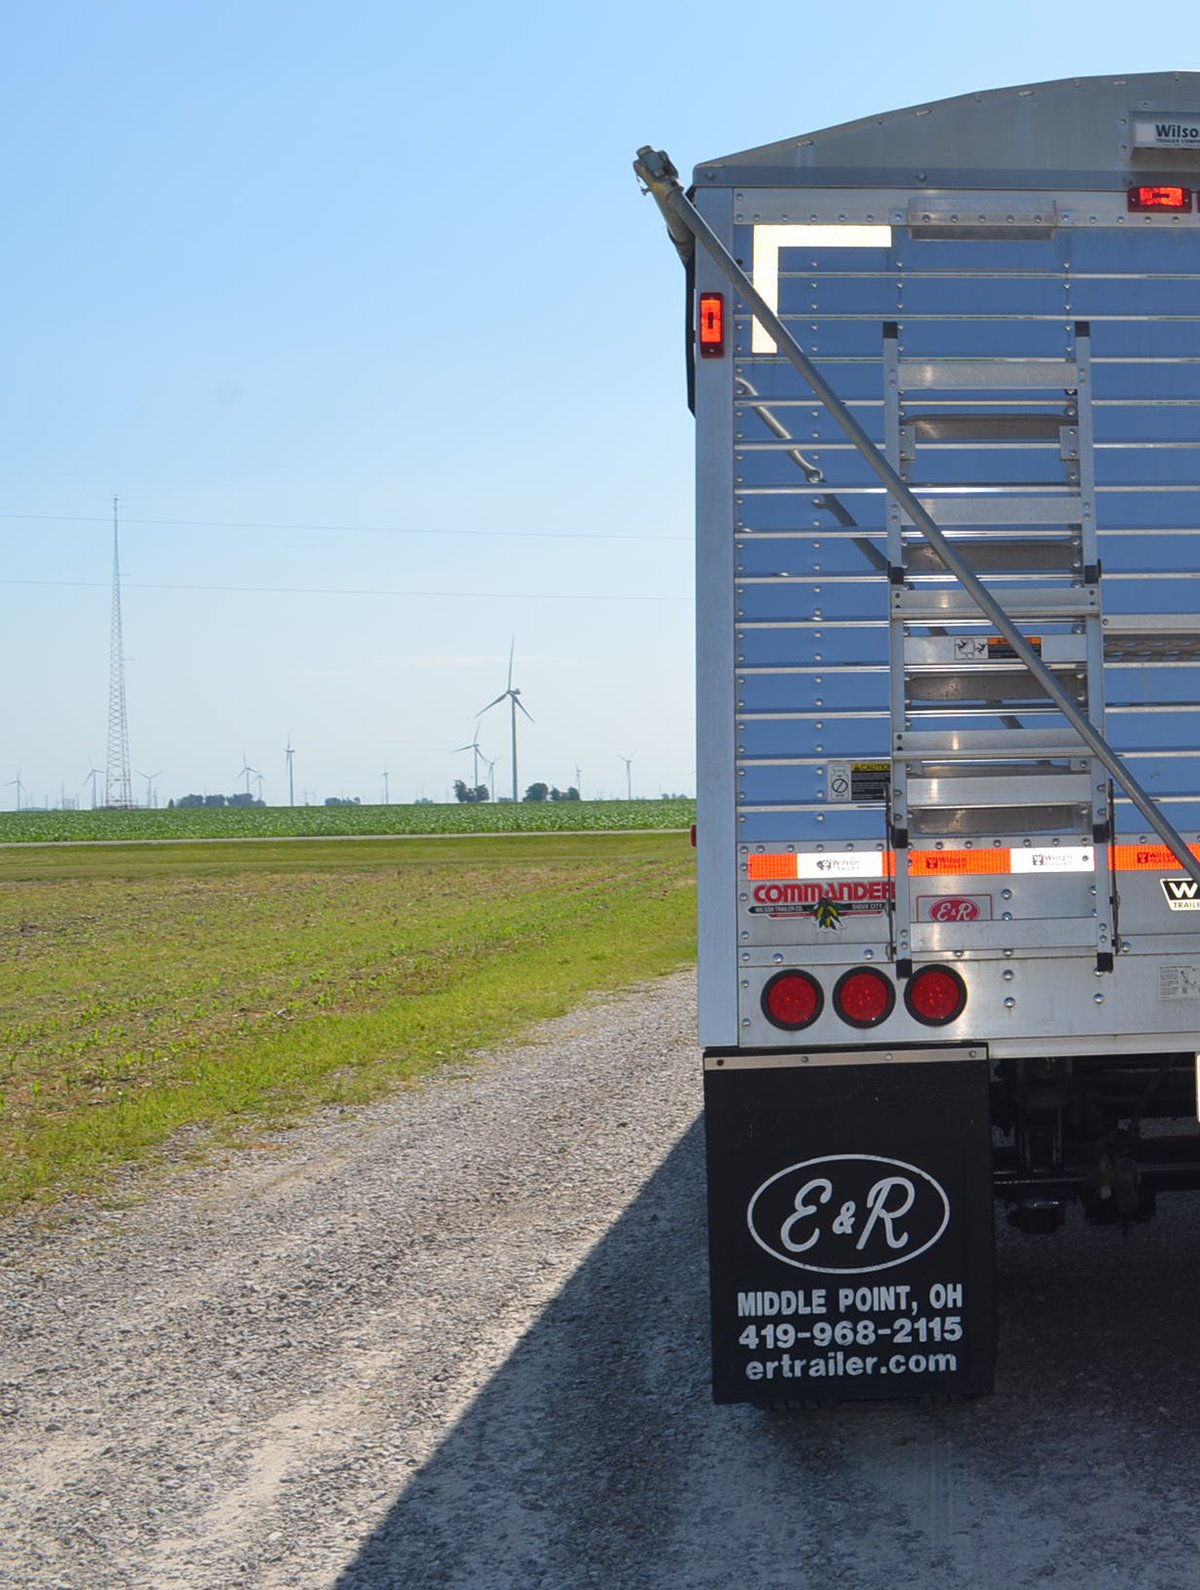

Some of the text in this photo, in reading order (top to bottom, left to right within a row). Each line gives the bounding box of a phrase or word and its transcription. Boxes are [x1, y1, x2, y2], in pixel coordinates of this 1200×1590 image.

[737, 1283, 963, 1317] MIDDLE POINT, OH
[738, 1316, 963, 1349] 419-968-2115
[745, 1351, 957, 1380] ertrailer.com
